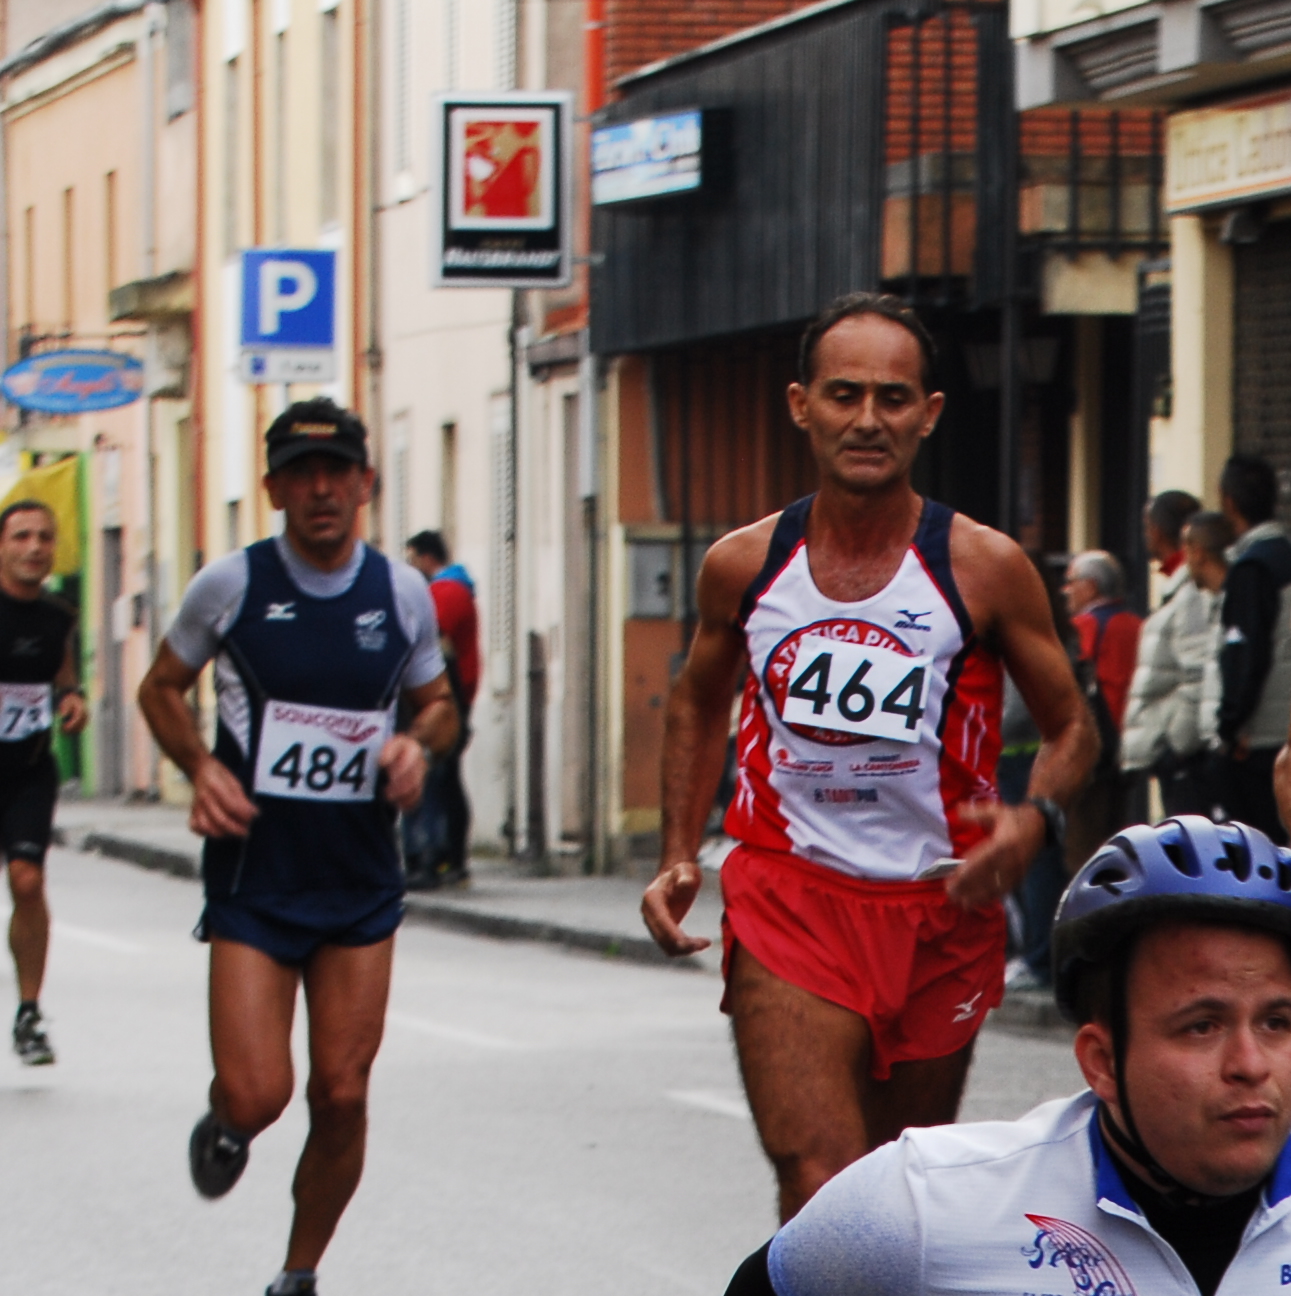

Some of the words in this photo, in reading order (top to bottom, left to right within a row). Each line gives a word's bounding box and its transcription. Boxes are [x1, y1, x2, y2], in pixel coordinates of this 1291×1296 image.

[259, 260, 319, 335] P
[789, 652, 925, 730] 464
[270, 743, 369, 793] 484
